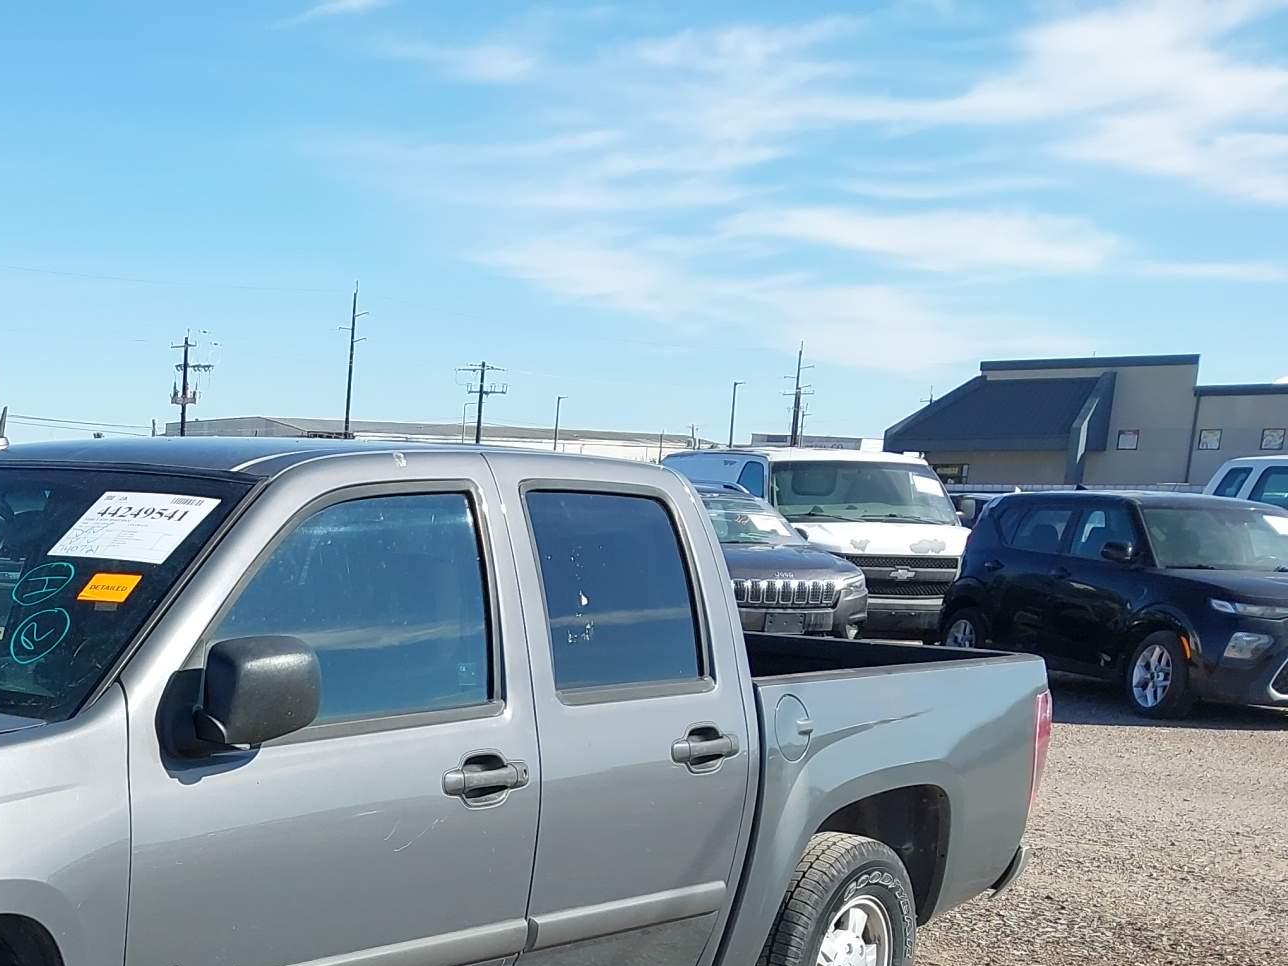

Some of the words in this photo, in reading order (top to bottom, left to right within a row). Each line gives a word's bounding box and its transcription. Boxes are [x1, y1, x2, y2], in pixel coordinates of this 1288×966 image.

[97, 505, 190, 522] 44249541
[88, 583, 128, 593] DETAILED
[843, 870, 913, 959] GOODYEAR
